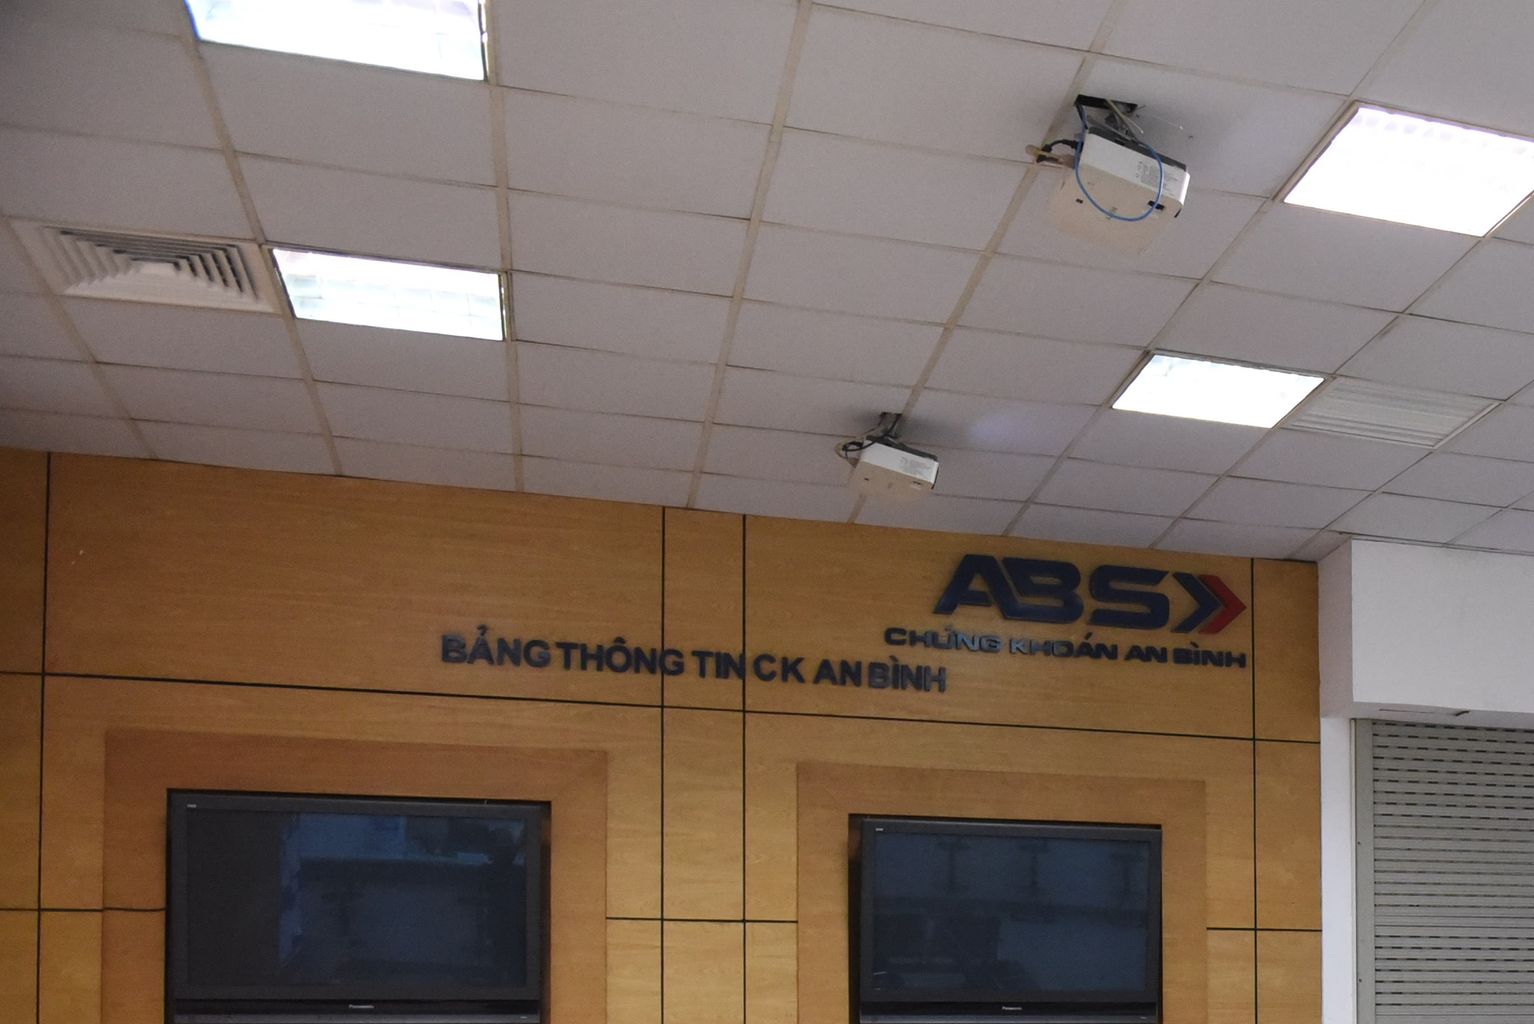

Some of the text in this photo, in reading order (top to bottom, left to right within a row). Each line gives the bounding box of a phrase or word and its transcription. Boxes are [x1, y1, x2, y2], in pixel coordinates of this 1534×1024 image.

[932, 554, 1171, 630] ABS
[441, 624, 550, 667] BẢNG
[556, 636, 684, 676] THÔNG
[692, 650, 745, 680] TIN
[813, 659, 862, 687] AN
[868, 655, 946, 693] BÌNH
[1009, 632, 1118, 660] KHOÁN
[1124, 645, 1168, 664] AN
[1172, 641, 1247, 668] BÌNH
